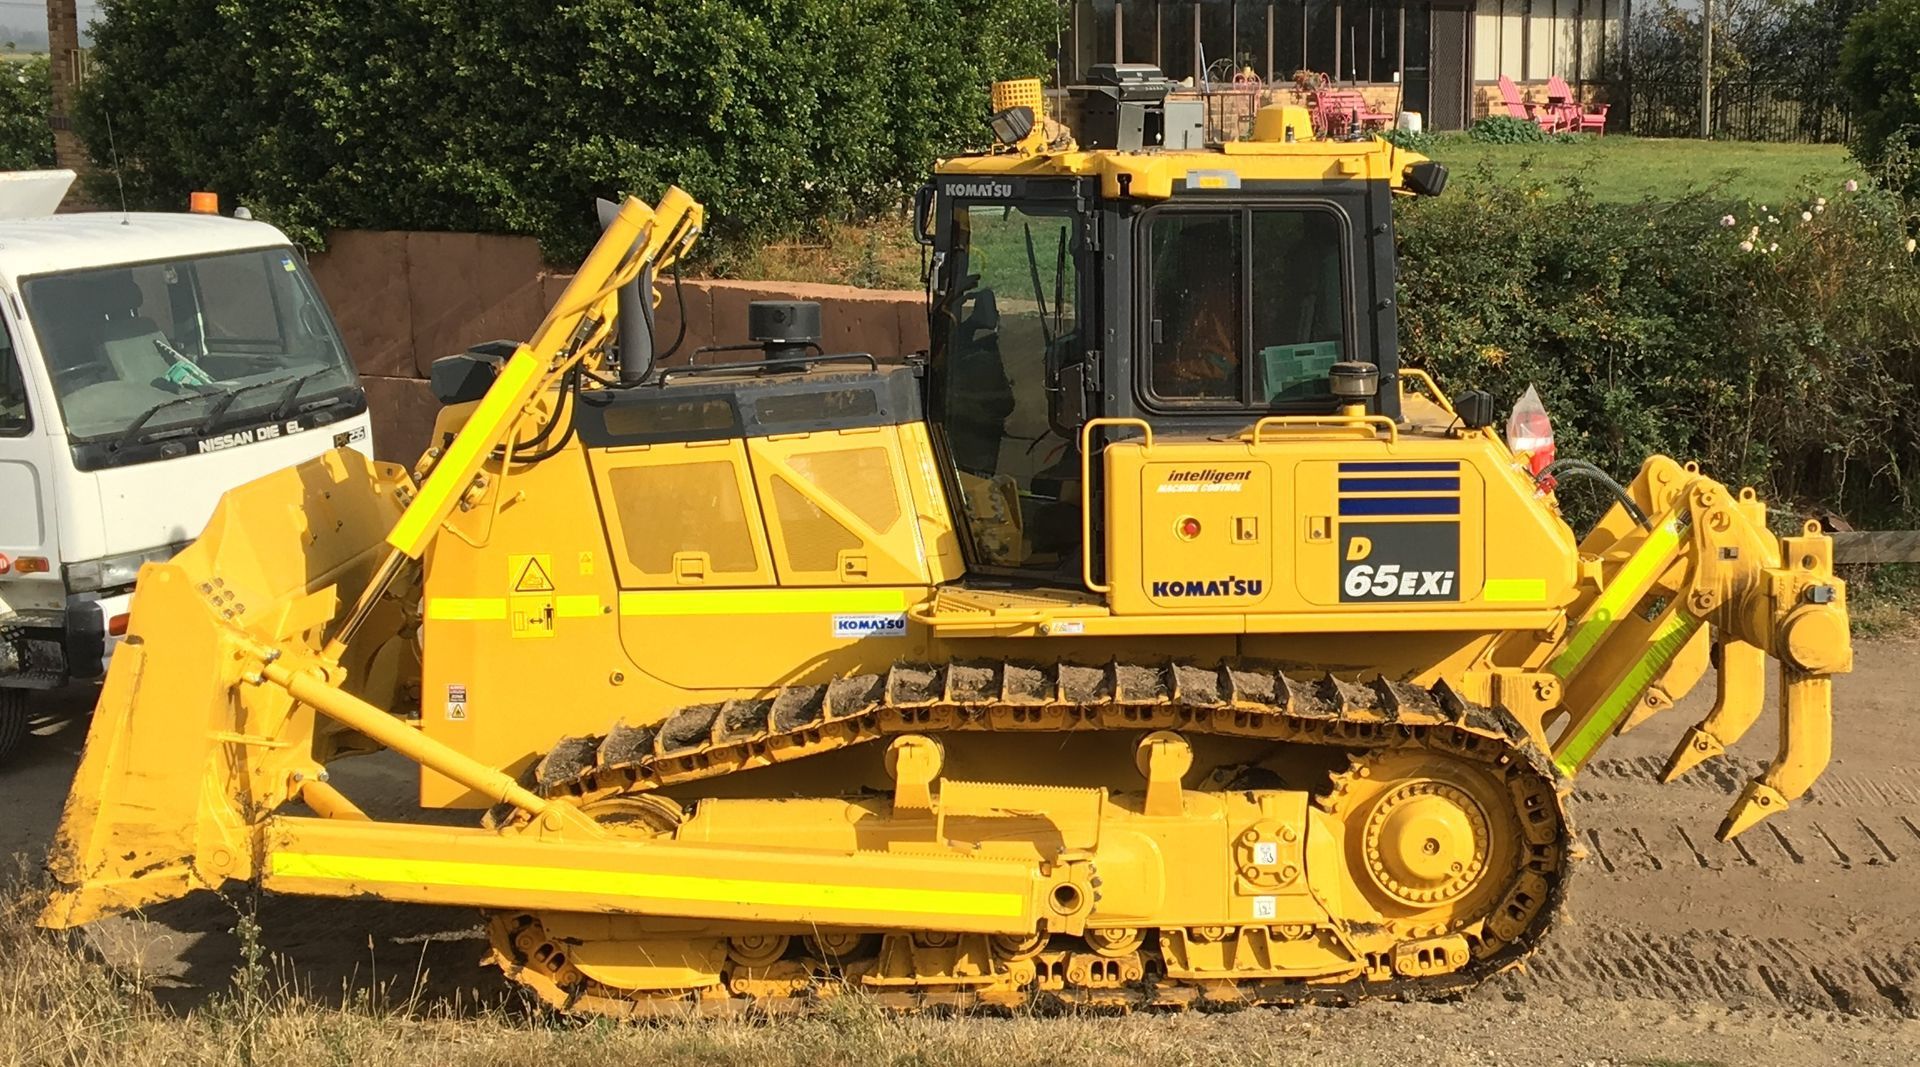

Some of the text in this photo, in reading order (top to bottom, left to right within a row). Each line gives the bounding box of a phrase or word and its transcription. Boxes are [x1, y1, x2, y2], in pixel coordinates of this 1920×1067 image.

[945, 181, 1012, 197] KOMATSU
[198, 430, 253, 453] NISSAN
[1167, 469, 1252, 484] intelligent
[1346, 536, 1372, 560] D
[1152, 575, 1263, 597] KOMATSU
[1344, 565, 1455, 597] 65EXi
[838, 617, 905, 630] KOMATSU
